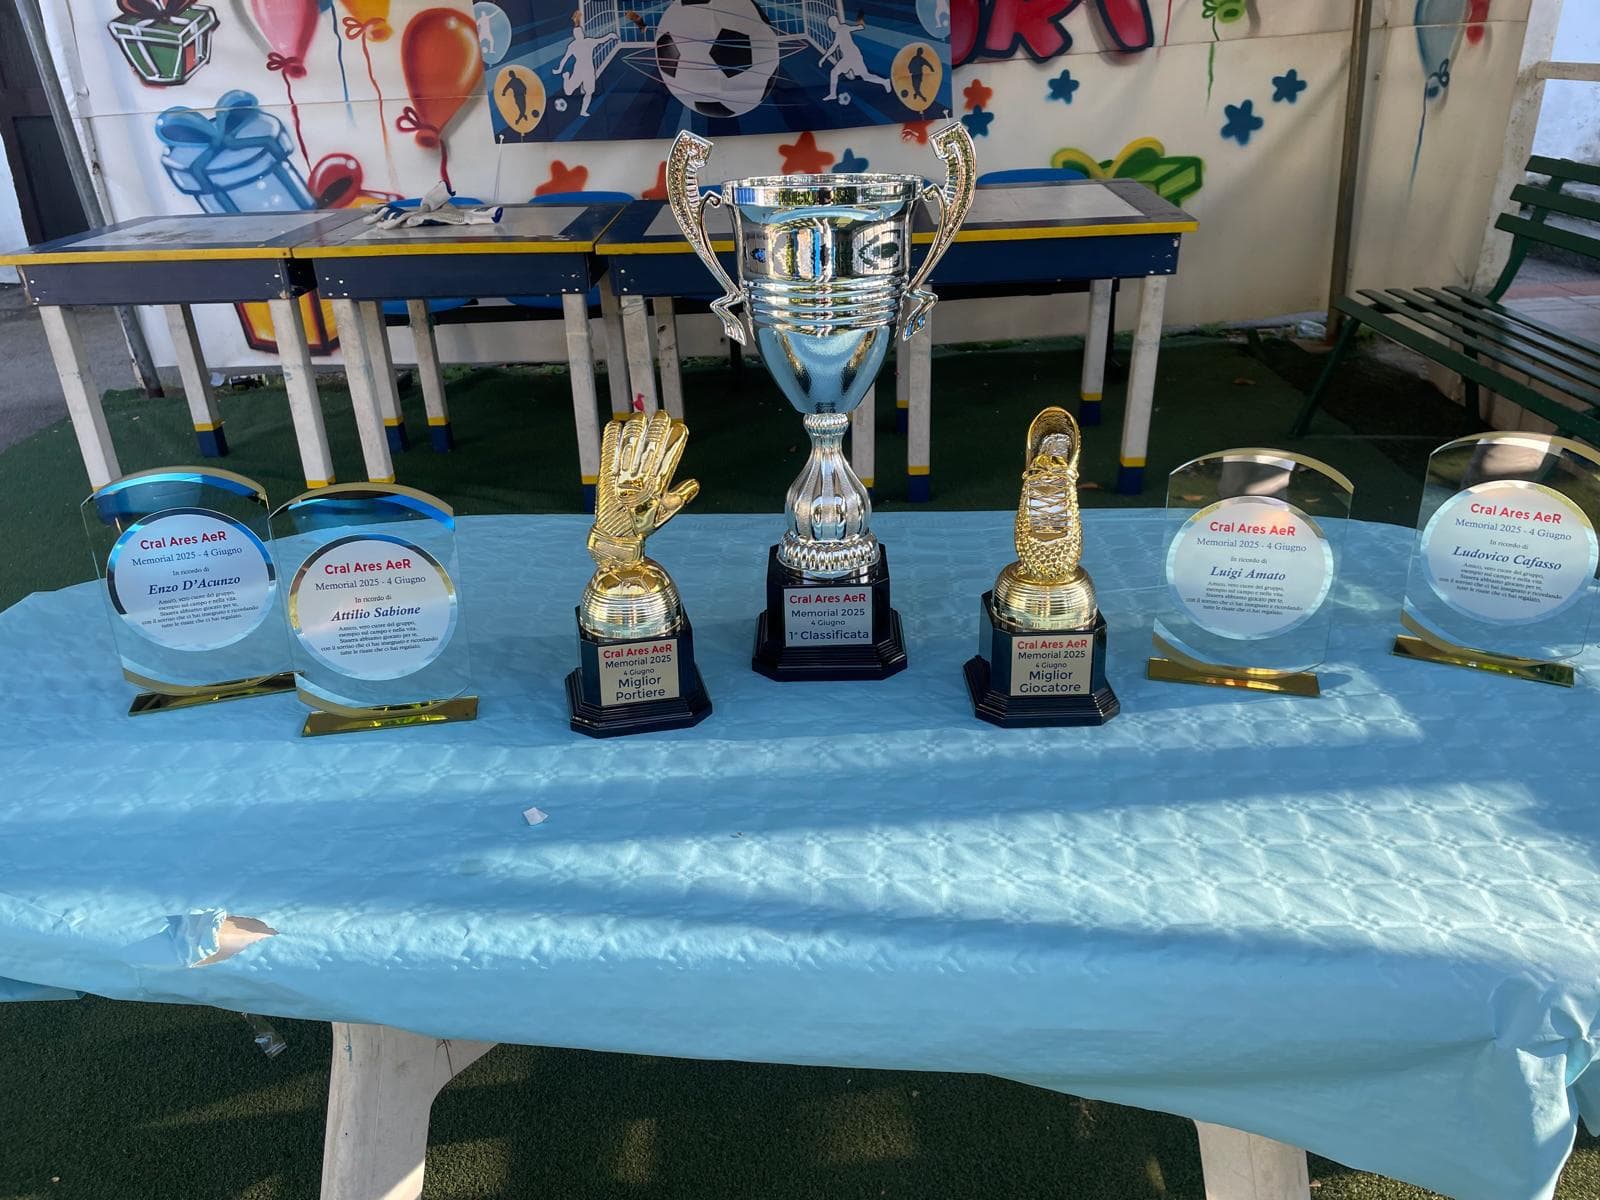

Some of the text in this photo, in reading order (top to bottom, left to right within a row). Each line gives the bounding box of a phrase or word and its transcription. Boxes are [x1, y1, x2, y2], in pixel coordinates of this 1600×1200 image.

[1470, 503, 1562, 524] Cral Ares AeR
[1209, 521, 1296, 536] Cral Ares AeR
[1455, 518, 1498, 531] Memorial
[1500, 524, 1521, 533] 2025
[1529, 528, 1535, 536] 4
[1537, 529, 1572, 541] Giugno
[140, 531, 227, 550] Cral Ares AeR
[1197, 537, 1237, 547] Memorial
[1239, 540, 1259, 549] 2025
[1266, 542, 1272, 550] 4
[1274, 542, 1307, 553] Giugno
[1498, 540, 1521, 548] ricordo
[131, 555, 174, 567] Memorial
[176, 552, 195, 561] 2025
[203, 550, 209, 558] 4
[211, 547, 243, 559] Giugno
[1238, 556, 1260, 564] ricordo
[1453, 546, 1562, 571] Ludovico Cafasso
[324, 559, 411, 575] Cral Ares AeR
[1210, 566, 1286, 581] Luigi Amato
[149, 576, 241, 595] Enzo D'Acunzo
[315, 581, 357, 591] Memorial
[360, 578, 379, 588] 2025
[387, 577, 392, 585] 4
[394, 576, 426, 586] Giugno
[363, 595, 385, 603] ricordo
[789, 593, 866, 604] Cral Ares AeR
[332, 606, 421, 621] Attilio Sabione
[791, 608, 865, 618] Memorial 2025
[817, 619, 846, 627] Giugno
[800, 629, 869, 640] Classificata
[1017, 639, 1088, 650] Cral Ares AeR
[603, 644, 672, 659] Cral Ares AeR
[1018, 650, 1086, 660] Memorial 2025
[605, 655, 672, 669] Memorial 2025
[1041, 662, 1067, 670] Giugno
[629, 668, 655, 677] Giugno
[1029, 670, 1073, 682] Miglior
[618, 676, 662, 689] Miglior
[1019, 682, 1081, 693] Giocatore
[616, 688, 666, 701] Portiere
